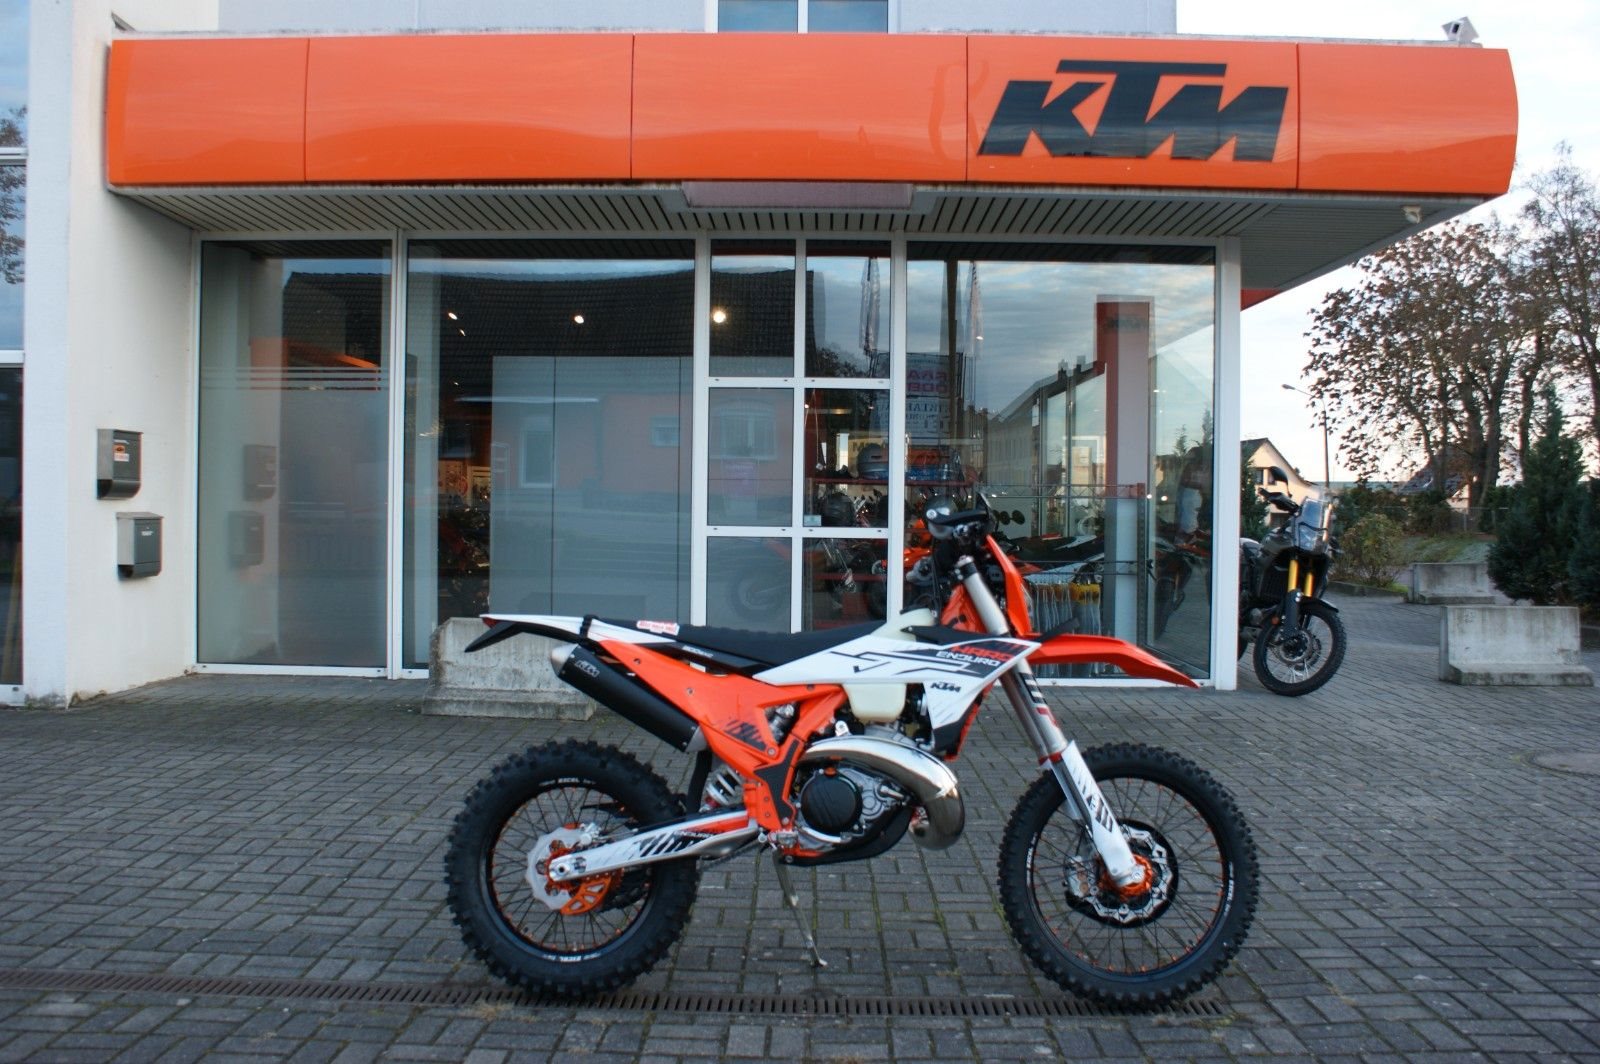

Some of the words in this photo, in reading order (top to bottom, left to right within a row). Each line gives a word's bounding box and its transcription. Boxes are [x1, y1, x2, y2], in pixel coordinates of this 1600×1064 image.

[977, 60, 1289, 163] KTM
[935, 651, 1001, 667] ENDURO
[575, 660, 600, 678] KTM
[930, 681, 961, 692] KTM
